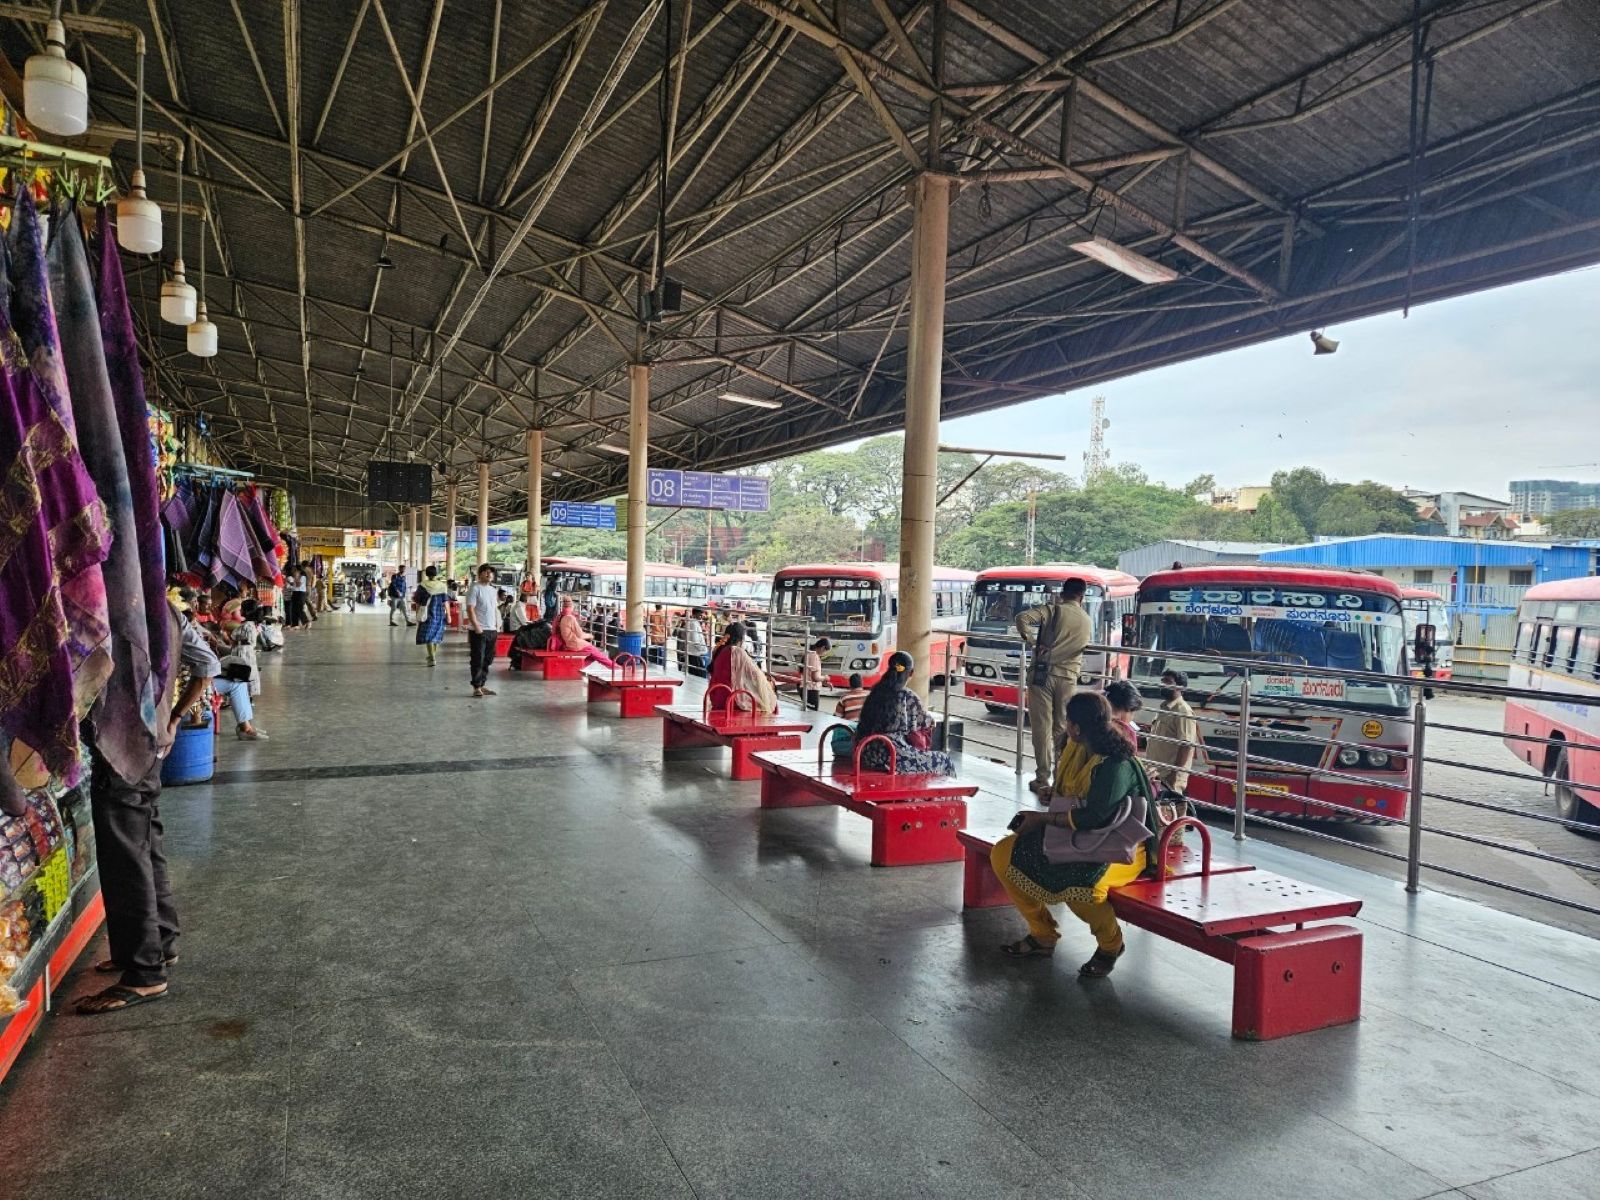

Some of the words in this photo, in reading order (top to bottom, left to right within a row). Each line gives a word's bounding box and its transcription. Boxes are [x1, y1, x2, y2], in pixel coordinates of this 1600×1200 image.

[651, 478, 675, 497] 08
[551, 507, 567, 520] 09
[456, 530, 468, 538] 10
